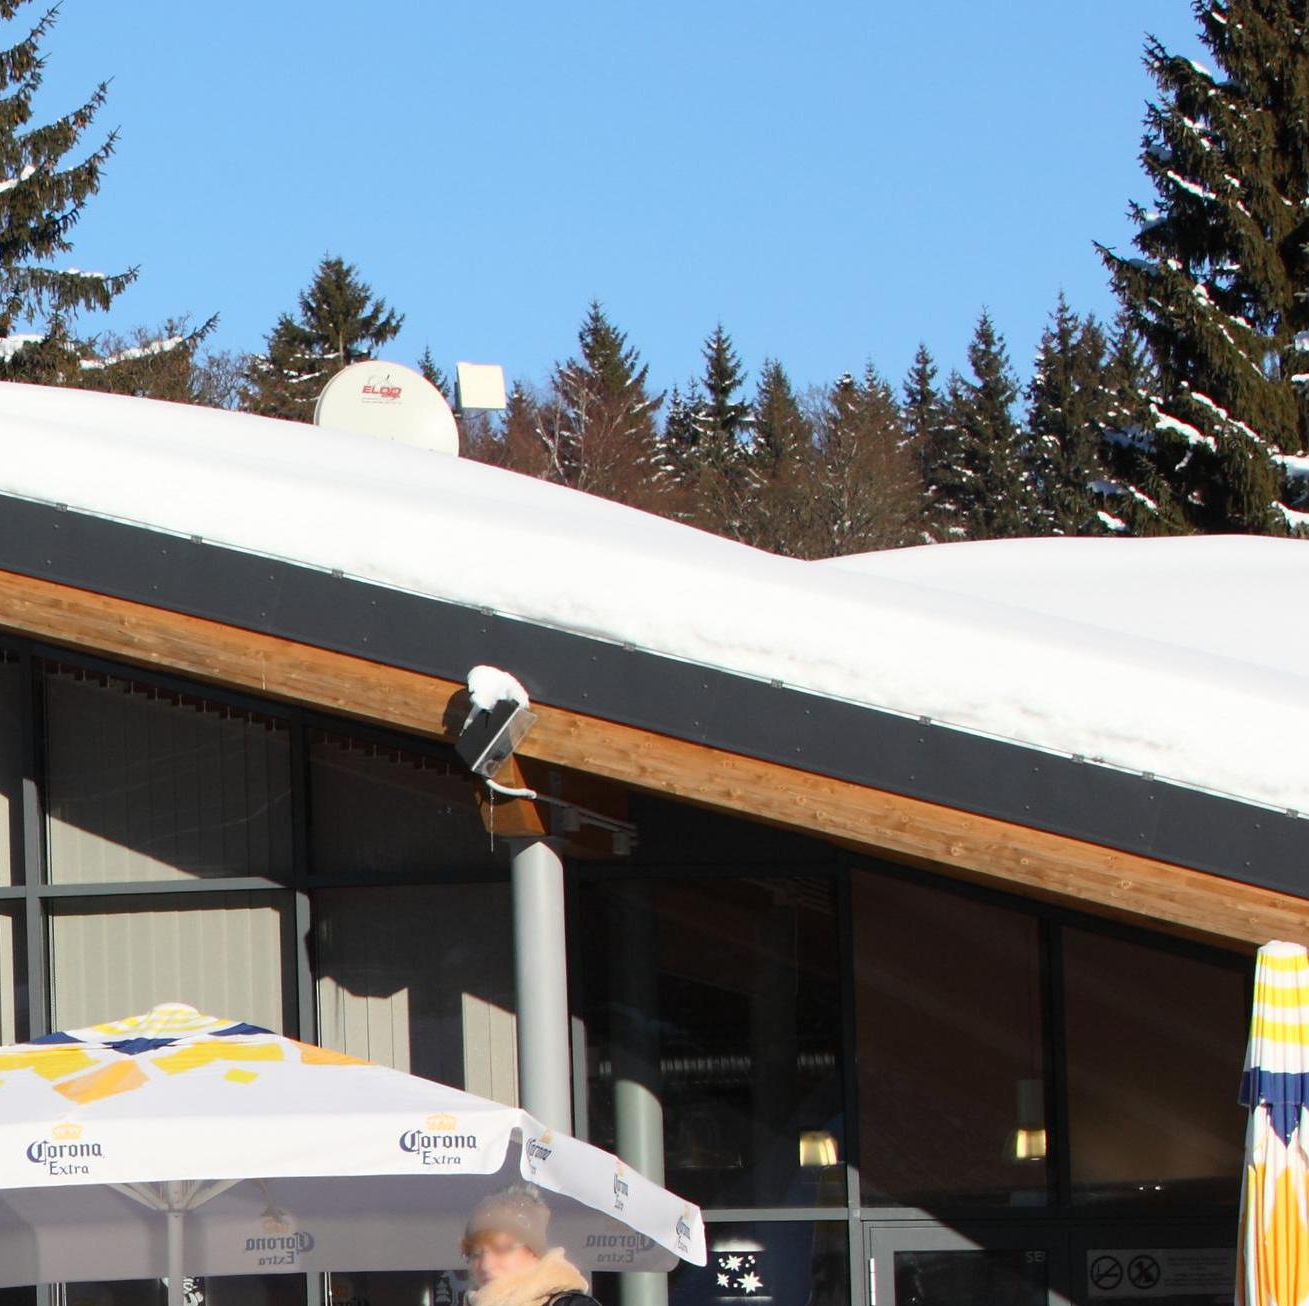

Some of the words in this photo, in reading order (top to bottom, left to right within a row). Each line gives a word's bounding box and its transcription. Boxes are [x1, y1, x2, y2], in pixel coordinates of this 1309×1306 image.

[399, 1130, 477, 1155] Corona
[26, 1140, 103, 1165] Corona
[422, 1151, 461, 1165] Extra
[49, 1161, 89, 1175] Extra
